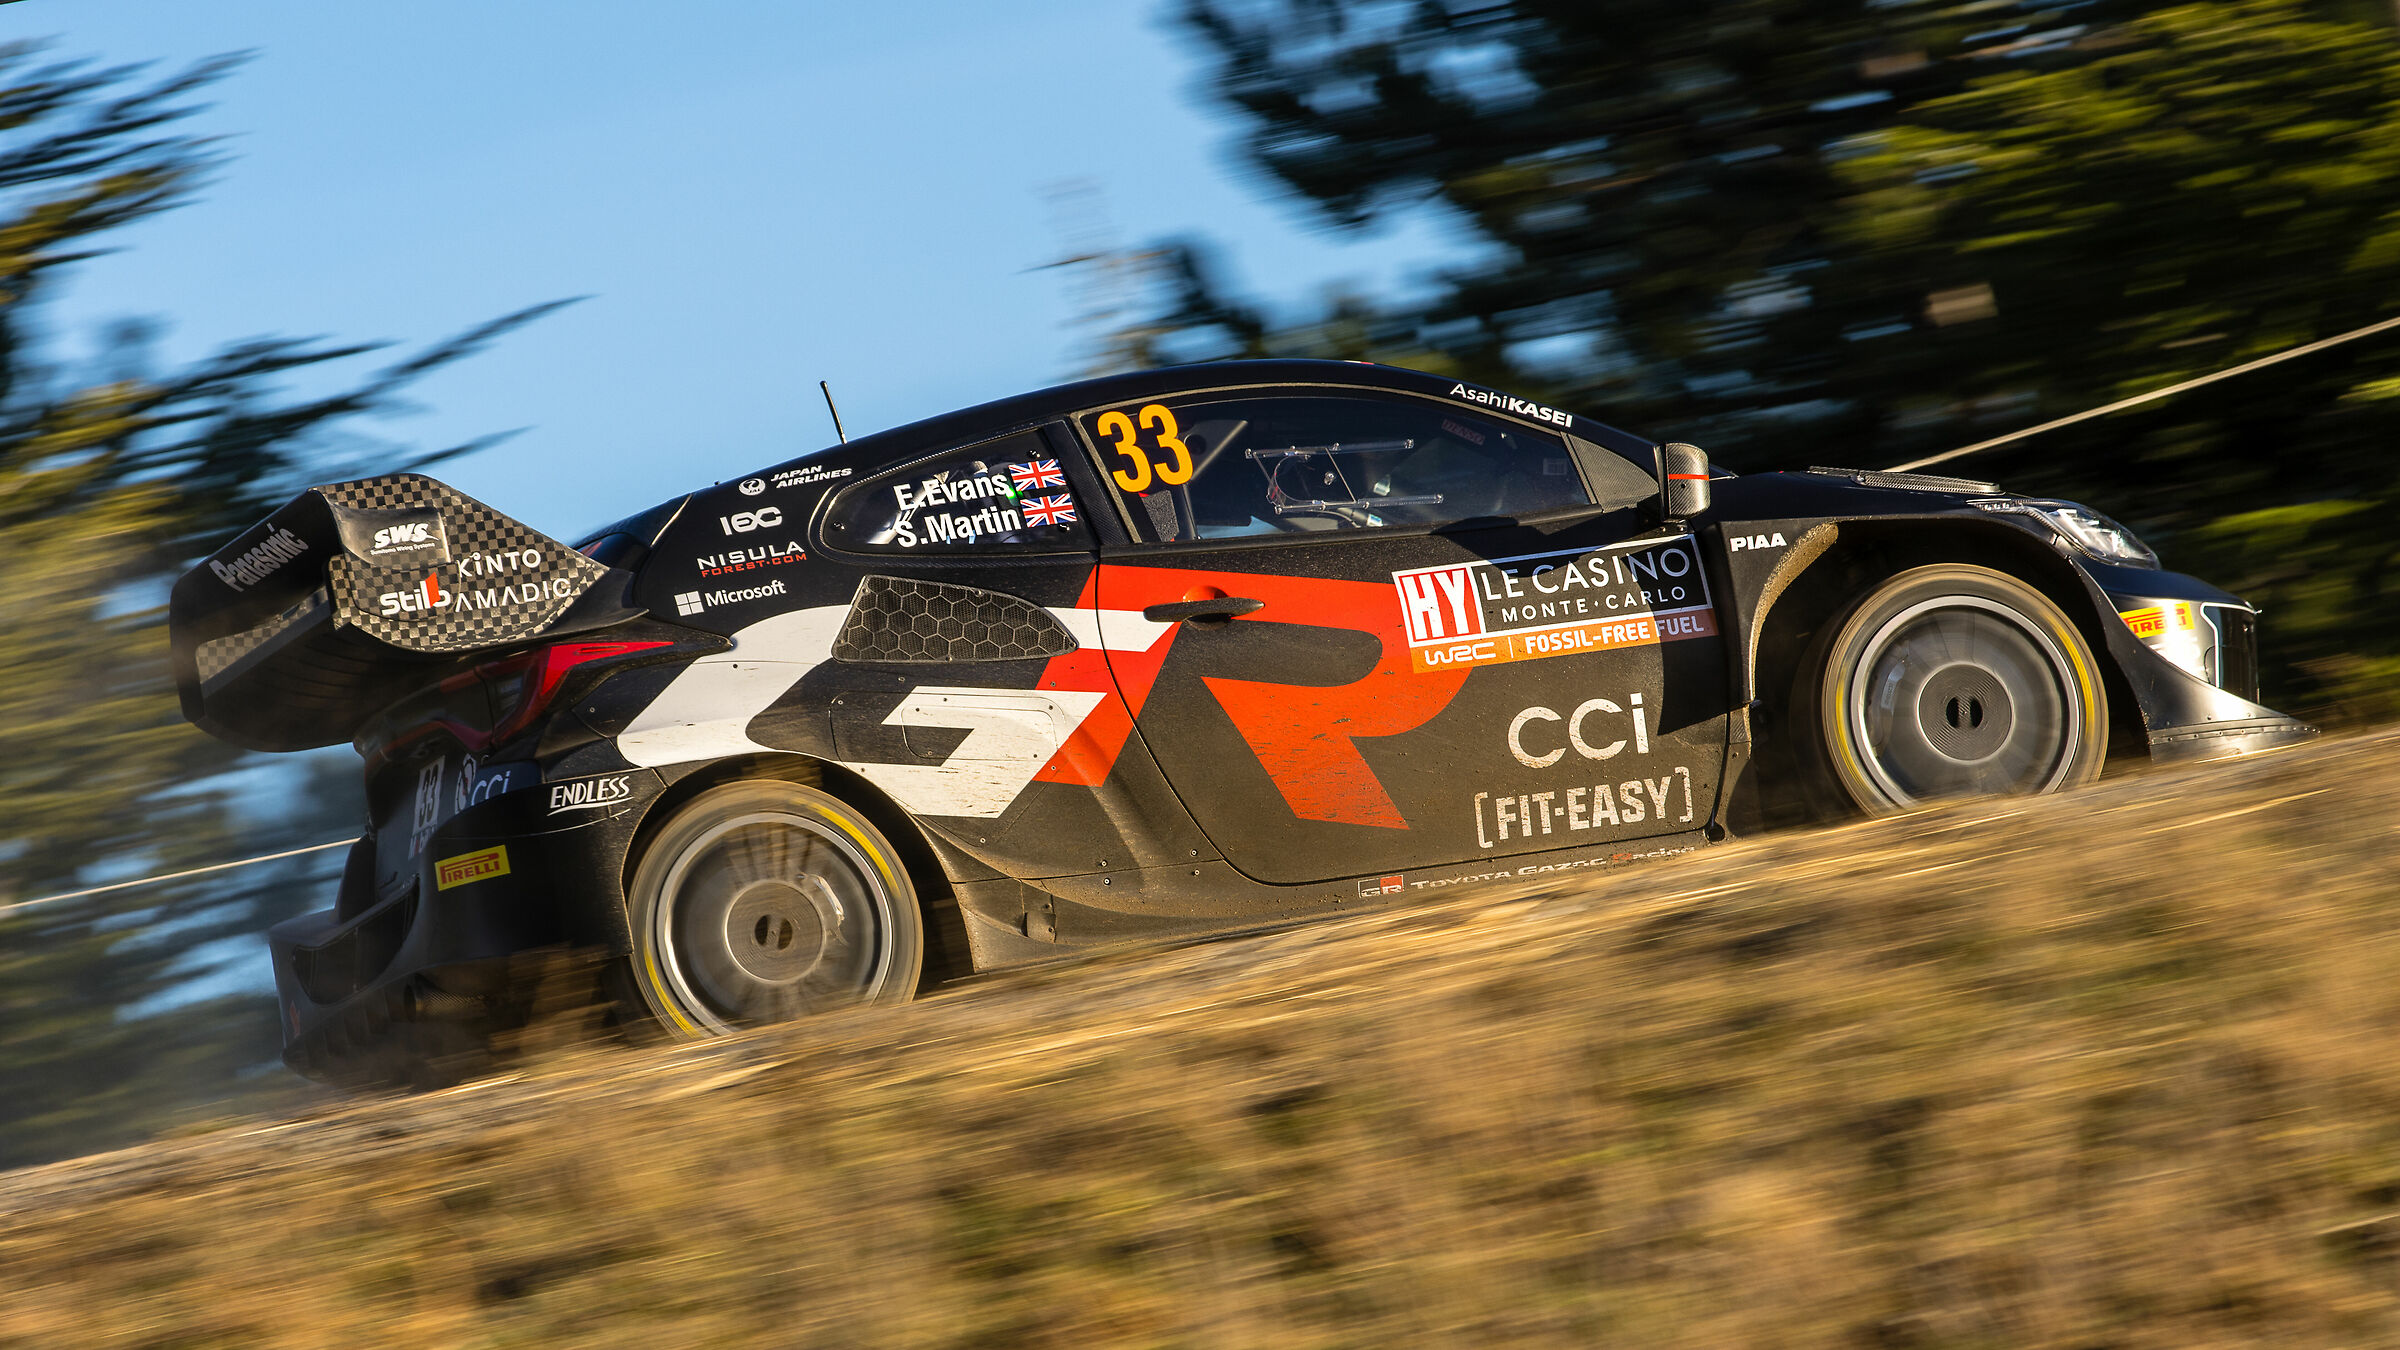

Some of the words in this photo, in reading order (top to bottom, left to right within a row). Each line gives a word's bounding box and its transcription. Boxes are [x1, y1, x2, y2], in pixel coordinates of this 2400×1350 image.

[1097, 404, 1194, 493] 33
[771, 465, 822, 482] JAPAN
[776, 468, 852, 489] AIRLINES
[374, 523, 439, 549] SWS
[1730, 532, 1788, 552] PIAA
[208, 522, 309, 592] Panasonic
[697, 541, 804, 570] NISULA
[1481, 567, 1524, 600] LE
[1532, 548, 1691, 595] CASINO
[379, 571, 452, 616] Stilo
[705, 579, 787, 607] Microsoft
[1401, 568, 1474, 639] HY
[1424, 642, 1497, 666] WRC
[1524, 620, 1652, 655] FOSSIL-FREE
[1656, 614, 1705, 638] FUEL
[418, 764, 439, 829] 33
[550, 775, 630, 809] ENDLESS
[440, 852, 500, 885] PIRELLI
